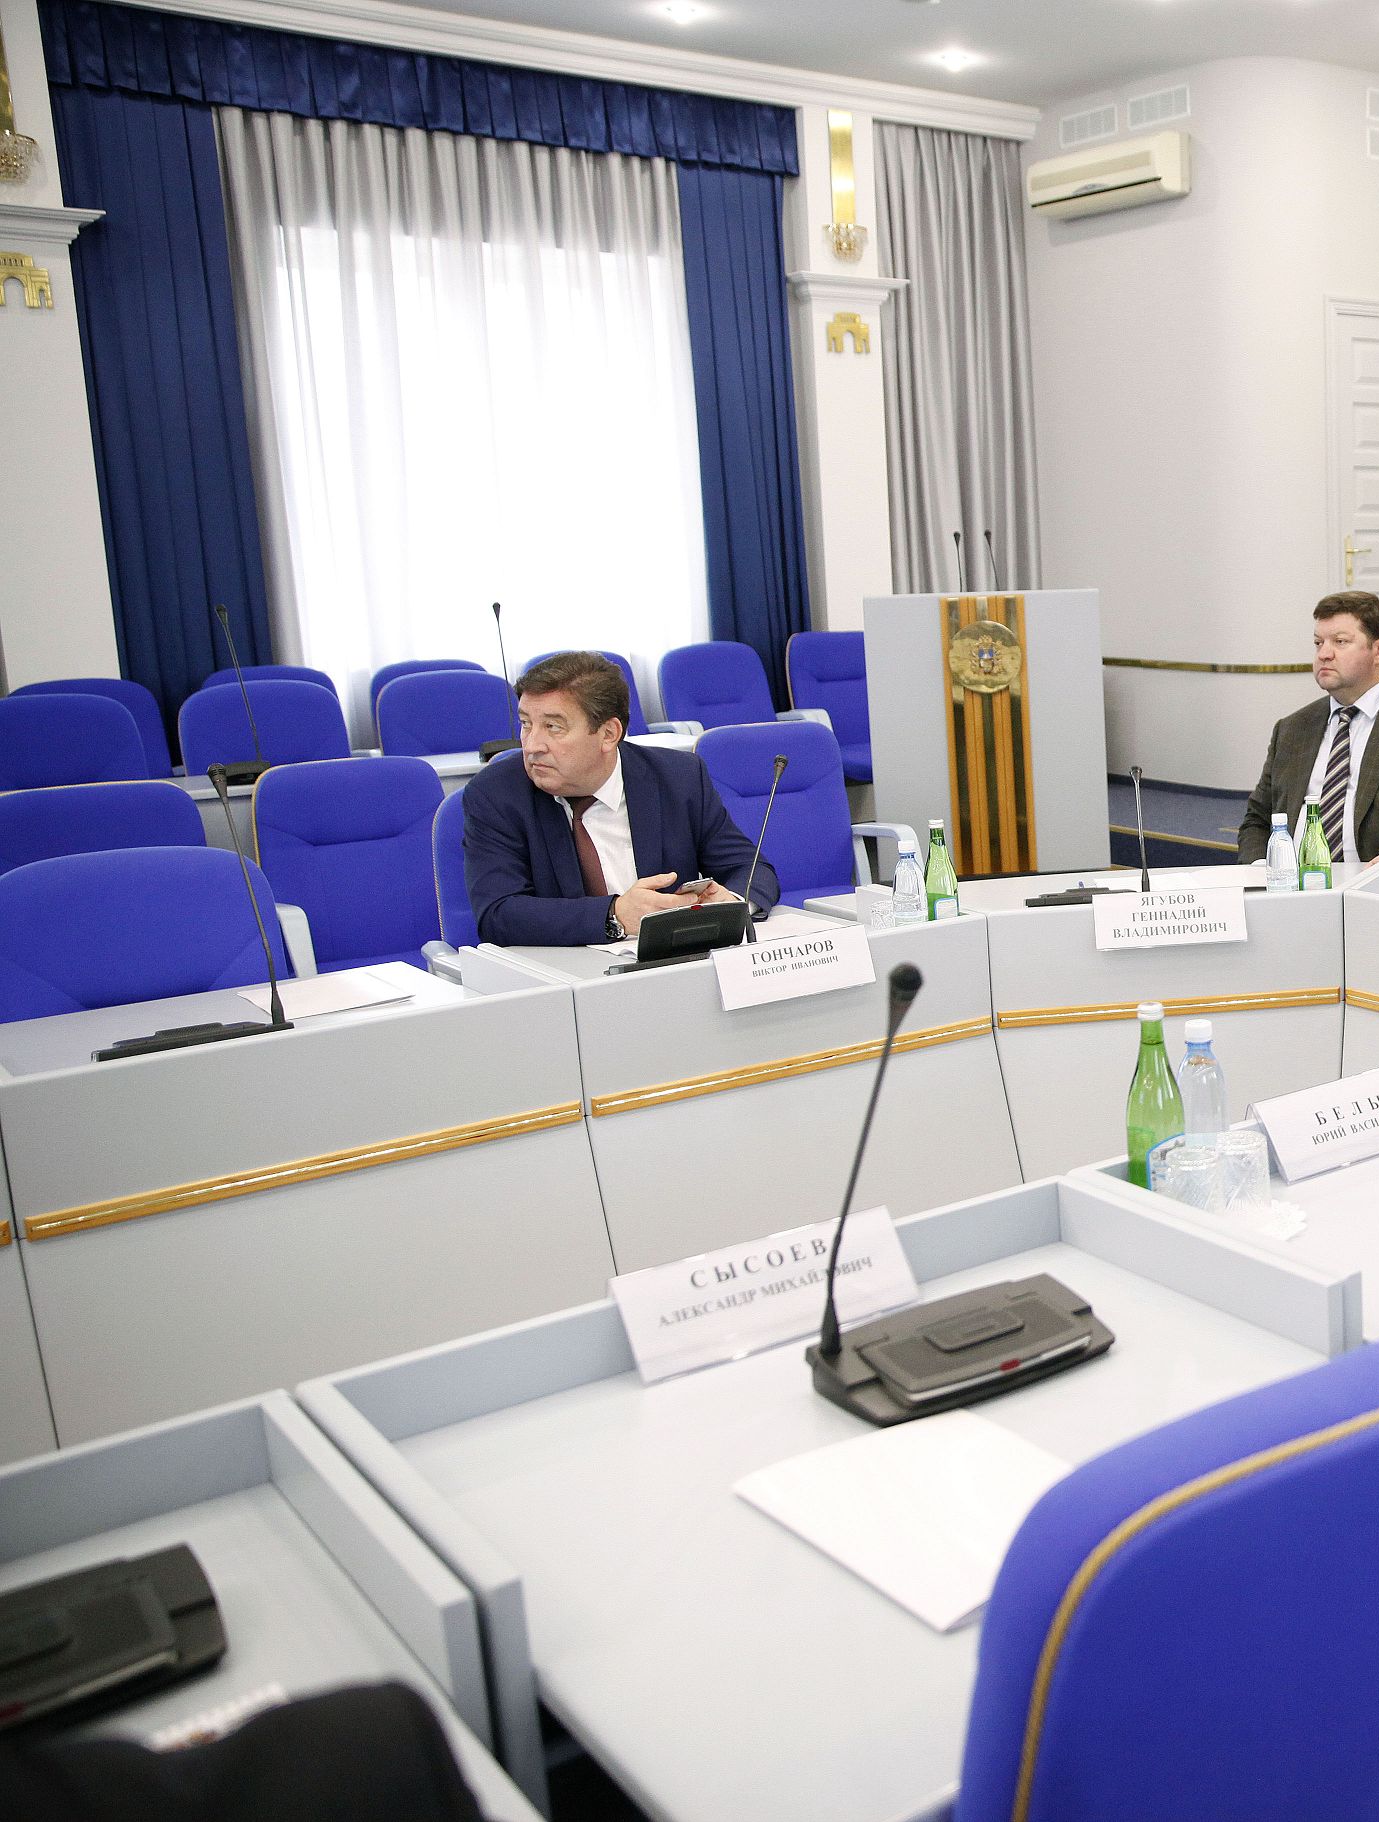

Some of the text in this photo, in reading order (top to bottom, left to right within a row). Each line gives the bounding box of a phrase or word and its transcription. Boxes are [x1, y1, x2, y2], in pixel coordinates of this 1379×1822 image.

[1141, 894, 1195, 907] ЯГУБОВ
[1132, 906, 1206, 922] ГЕННАДИЙ
[1112, 922, 1227, 938] ВЛАДИМИРОВИЧ
[751, 939, 834, 965] ГОНЧАРОВ
[752, 955, 839, 978] ВИКТОР ИВАНОВИЧ
[1312, 1126, 1347, 1145] ЮРИЙ
[690, 1238, 828, 1289] СЫСОЕВ
[659, 1290, 756, 1327] АЛЕКСАНДР
